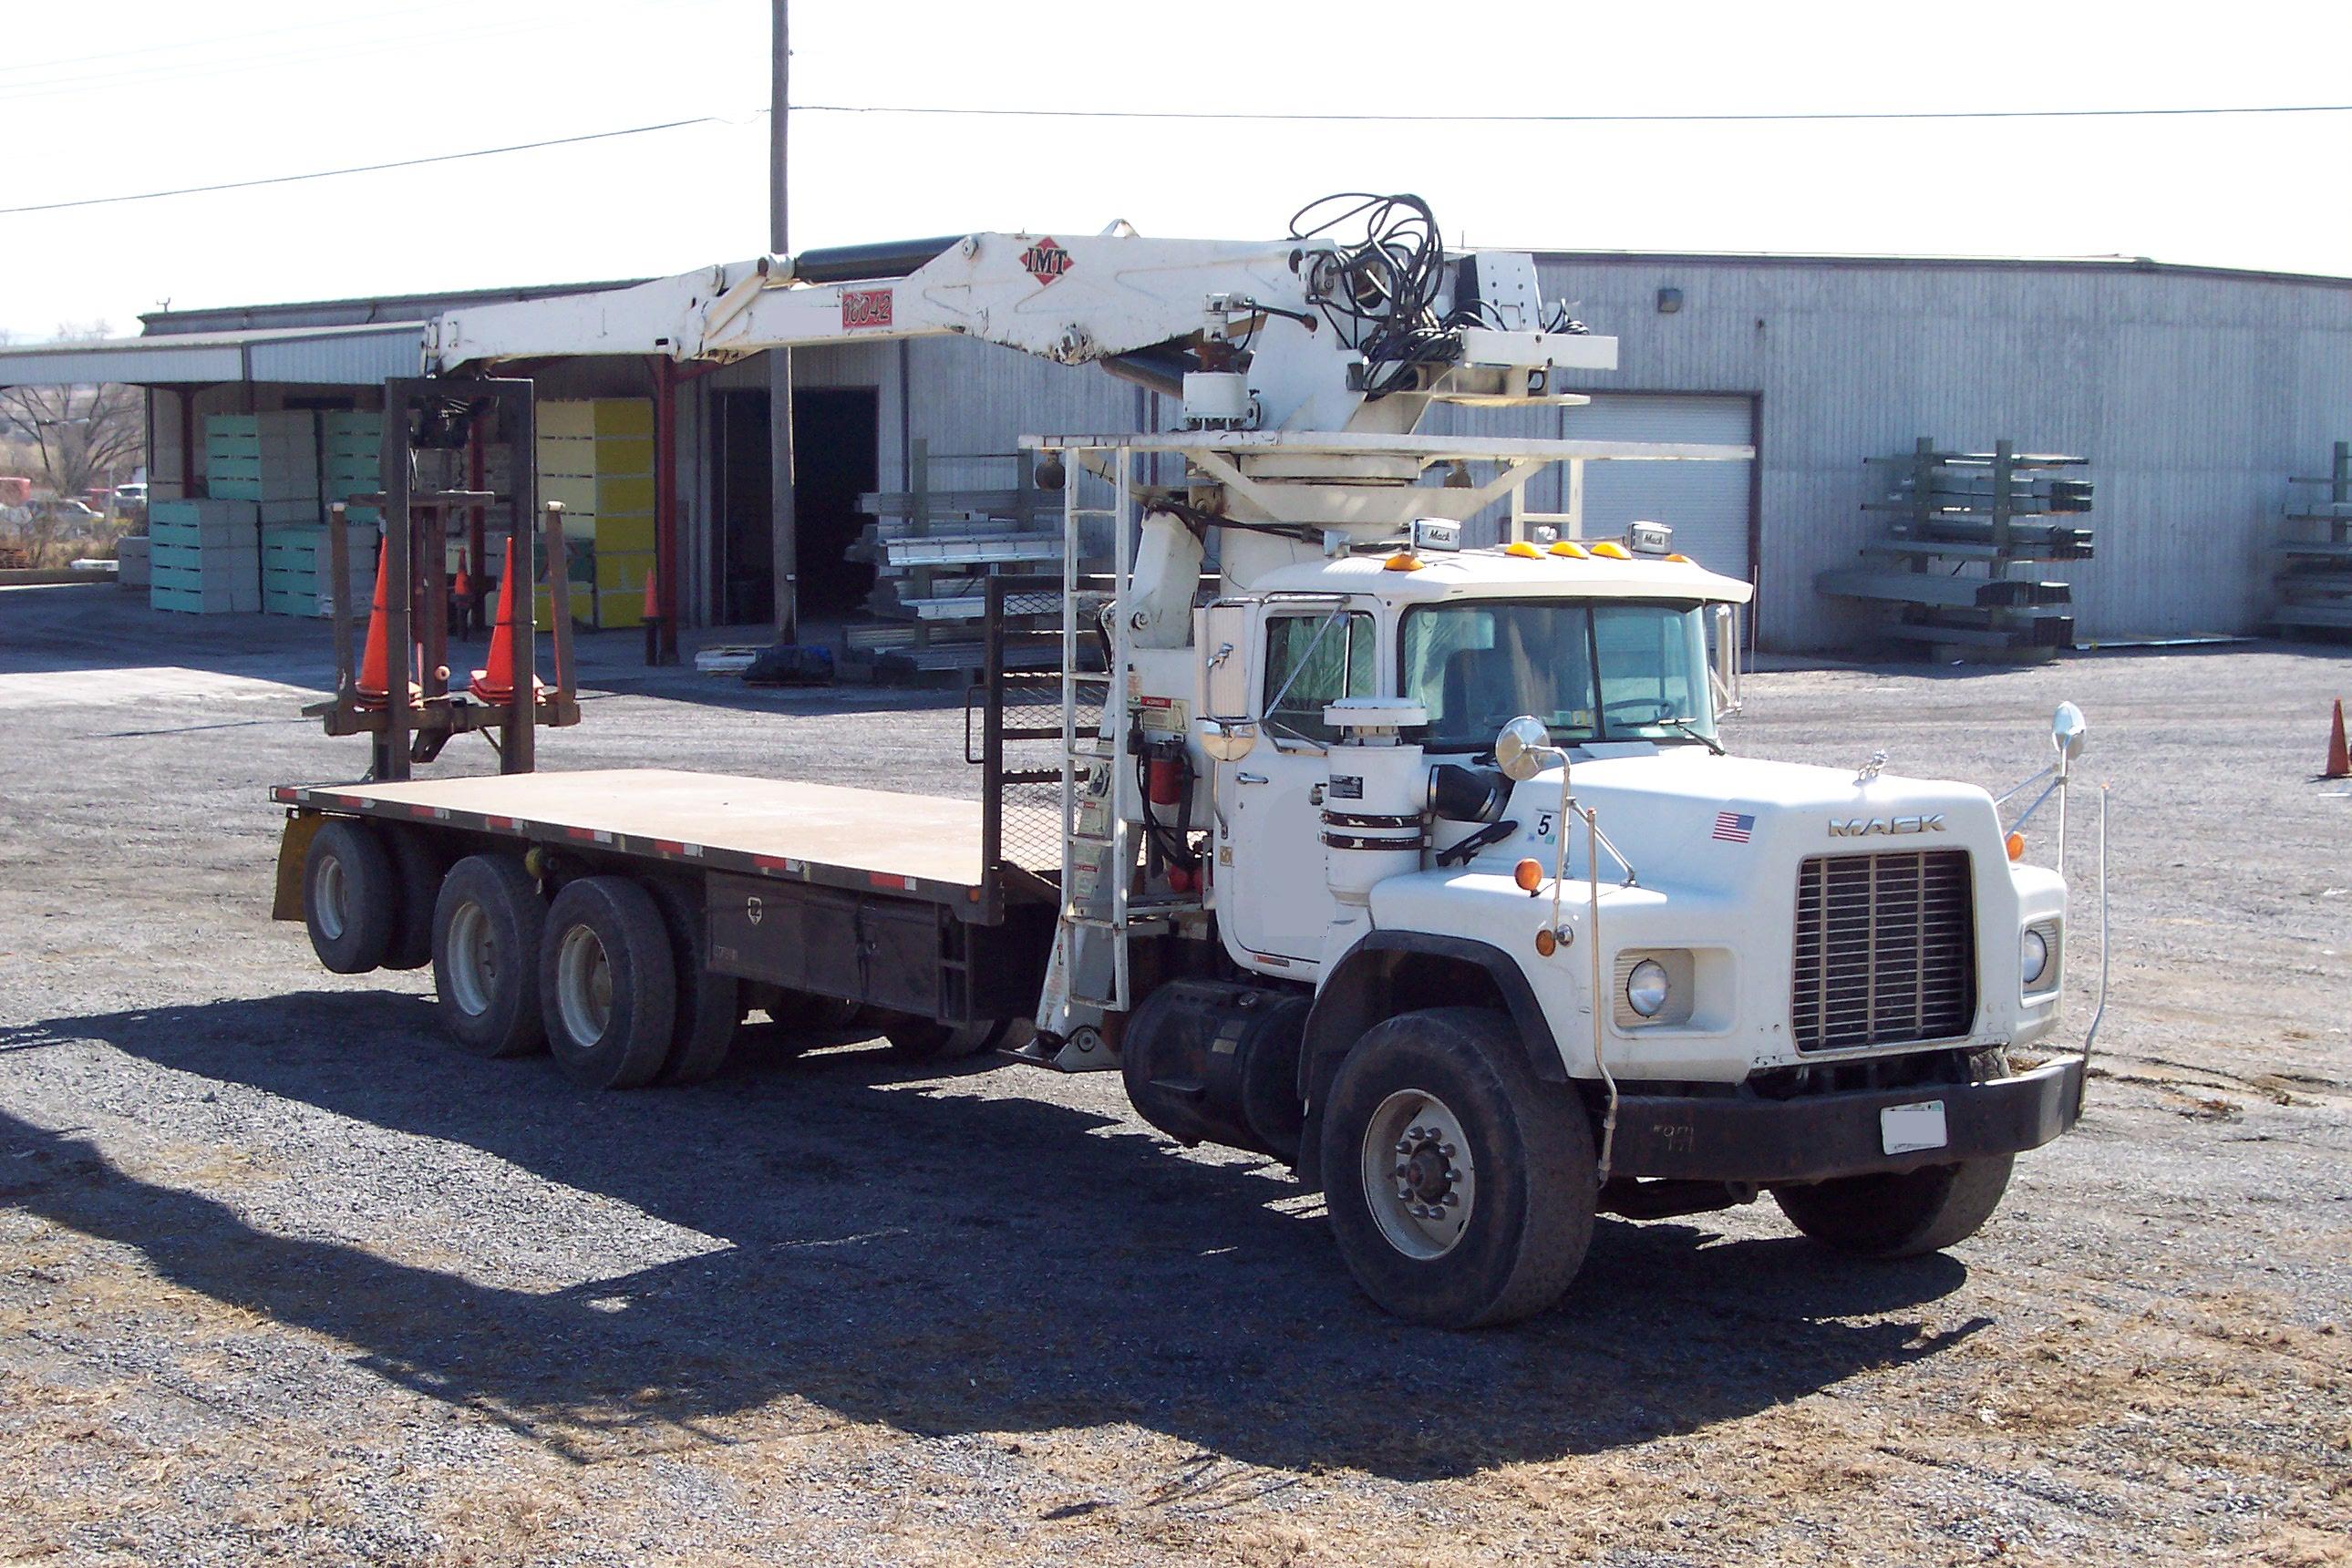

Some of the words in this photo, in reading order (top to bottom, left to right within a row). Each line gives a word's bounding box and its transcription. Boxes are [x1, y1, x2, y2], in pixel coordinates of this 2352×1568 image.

[1026, 247, 1068, 275] IMT
[1429, 529, 1450, 542] Mack
[1538, 814, 1552, 836] 5
[1829, 813, 1946, 837] MACK
